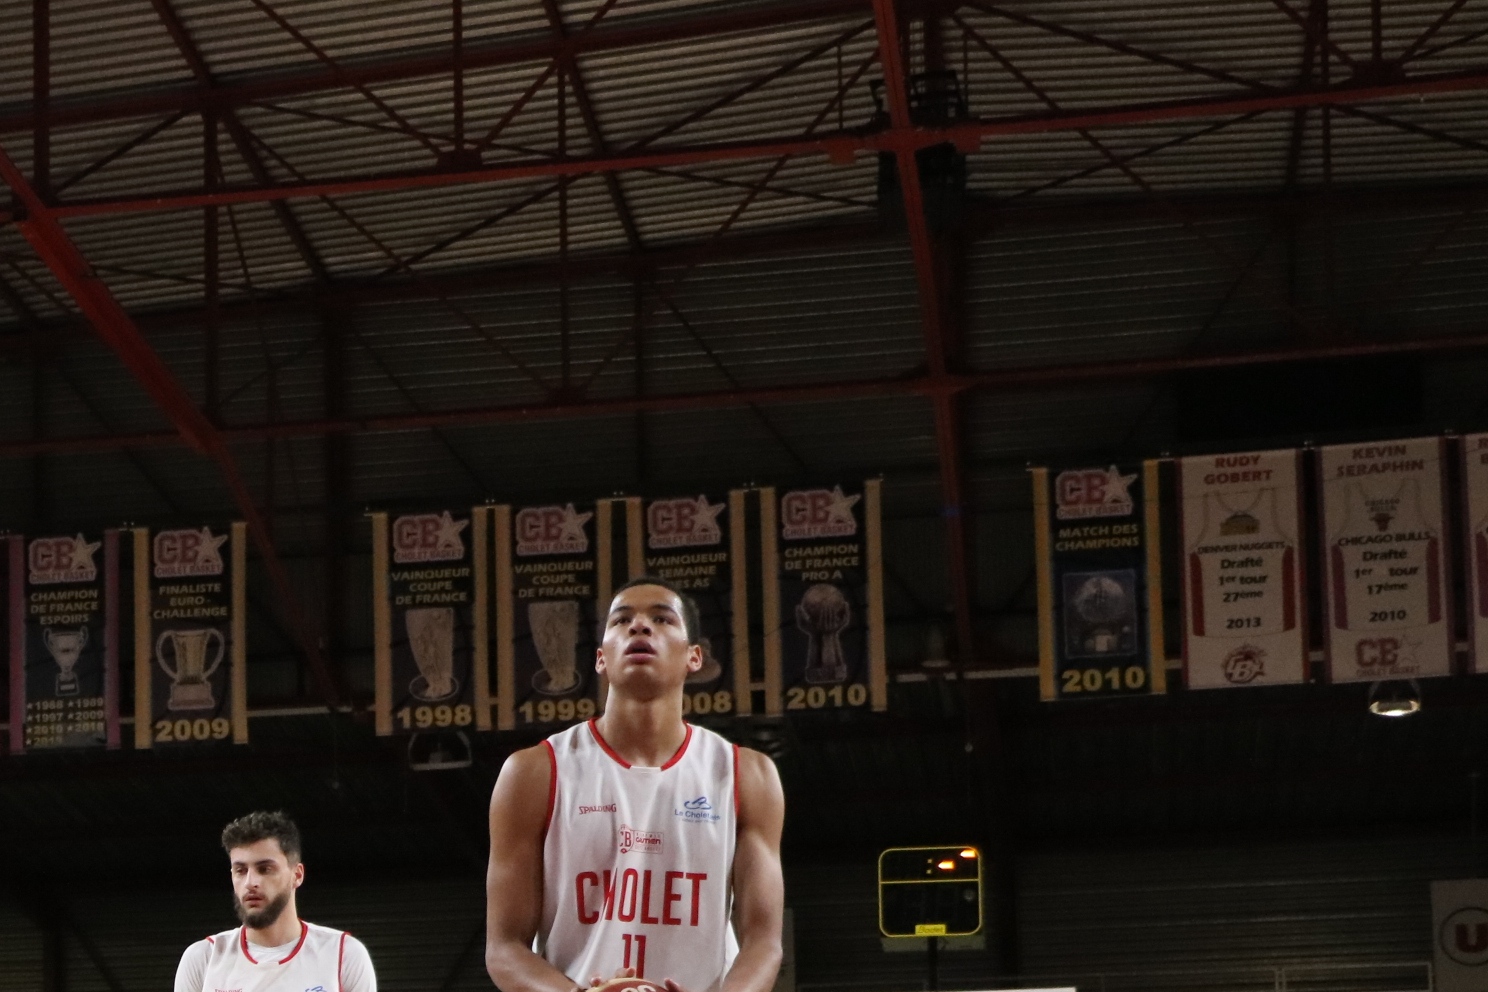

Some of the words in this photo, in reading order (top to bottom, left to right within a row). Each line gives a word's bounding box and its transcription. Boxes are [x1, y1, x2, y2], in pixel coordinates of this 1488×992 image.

[1352, 444, 1407, 460] KEVIN
[1214, 454, 1261, 469] RUDY
[1336, 459, 1425, 478] SERAPHIN
[1203, 469, 1273, 485] GOBERT
[1059, 525, 1110, 539] MATCH
[1113, 523, 1138, 535] DES
[1055, 536, 1140, 552] CHAMPIONS
[1239, 540, 1286, 552] NUGGETS
[1338, 533, 1393, 547] CHICAGO
[1395, 531, 1431, 543] BULLS
[785, 544, 859, 558] CHAMPION
[1362, 549, 1408, 563] Drafté
[648, 553, 727, 567] VAINQUEUR
[785, 561, 801, 571] DE
[805, 557, 859, 569] FRANCE
[1220, 556, 1263, 569] Drafté
[391, 567, 470, 581] VAINQUEUR
[514, 561, 593, 574] VAINQUEUR
[659, 565, 716, 578] SEMAINE
[1388, 566, 1420, 578] tour
[532, 574, 576, 585] COUPE
[693, 577, 710, 588] AS
[802, 571, 830, 581] PRO
[832, 570, 843, 580] A
[1239, 574, 1269, 586] tour
[159, 583, 221, 596] FINALISTE
[409, 580, 453, 592] COUPE
[518, 588, 535, 598] DE
[538, 585, 590, 597] FRANCE
[30, 589, 98, 602] CHAMPION
[395, 595, 412, 605] DE
[415, 592, 467, 604] FRANCE
[30, 604, 46, 614] DE
[49, 601, 98, 613] FRANCE
[153, 606, 228, 619] CHALLENGE
[39, 613, 89, 625] ESPOIRS
[1368, 608, 1407, 622] 2010
[1226, 616, 1262, 630] 2013
[1061, 666, 1146, 693] 2010
[786, 684, 867, 710] 2010
[397, 704, 472, 729] 1998
[519, 699, 595, 724] 1999
[155, 717, 230, 742] 2009
[578, 803, 618, 815] SPALDING
[574, 867, 708, 926] CHOLET
[622, 933, 647, 979] 11
